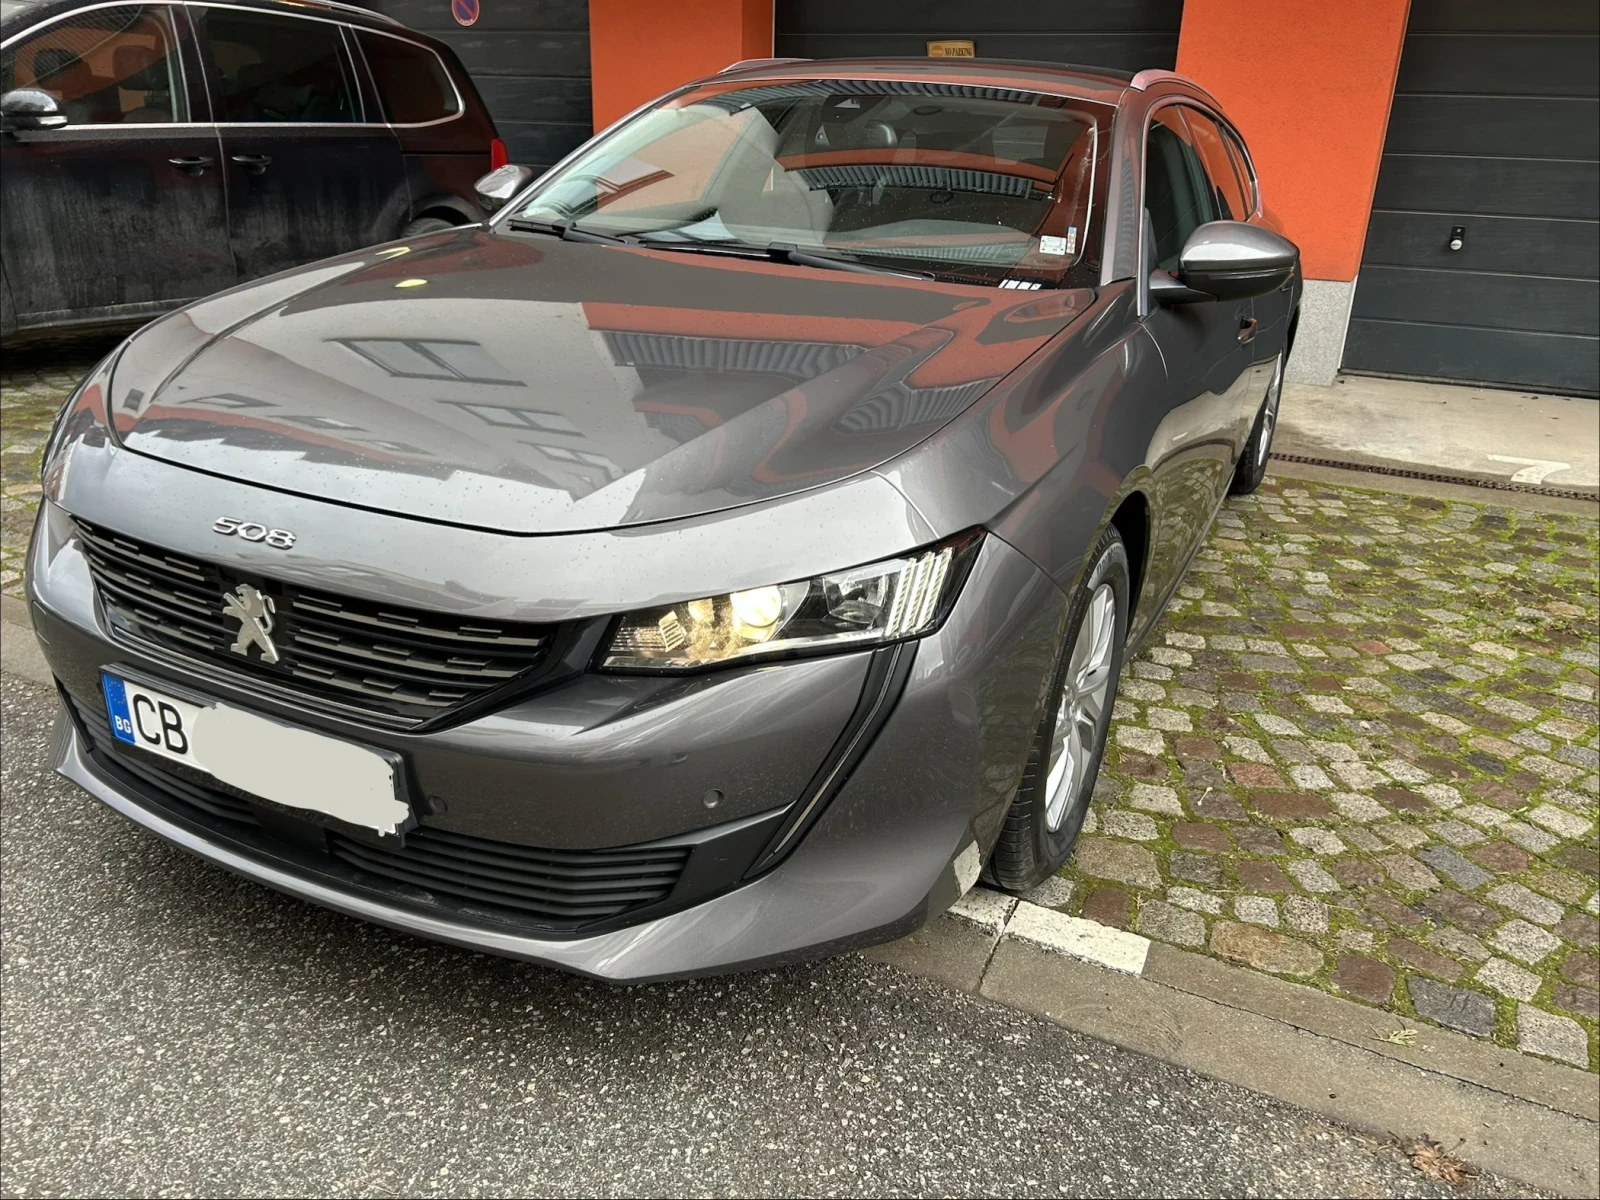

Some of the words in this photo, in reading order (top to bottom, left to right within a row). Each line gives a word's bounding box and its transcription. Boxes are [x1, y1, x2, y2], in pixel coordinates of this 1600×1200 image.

[945, 47, 951, 56] NO
[952, 47, 972, 57] PARKING
[1487, 454, 1571, 485] 7
[212, 516, 297, 550] 508
[114, 714, 132, 734] BG
[133, 693, 188, 754] CB
